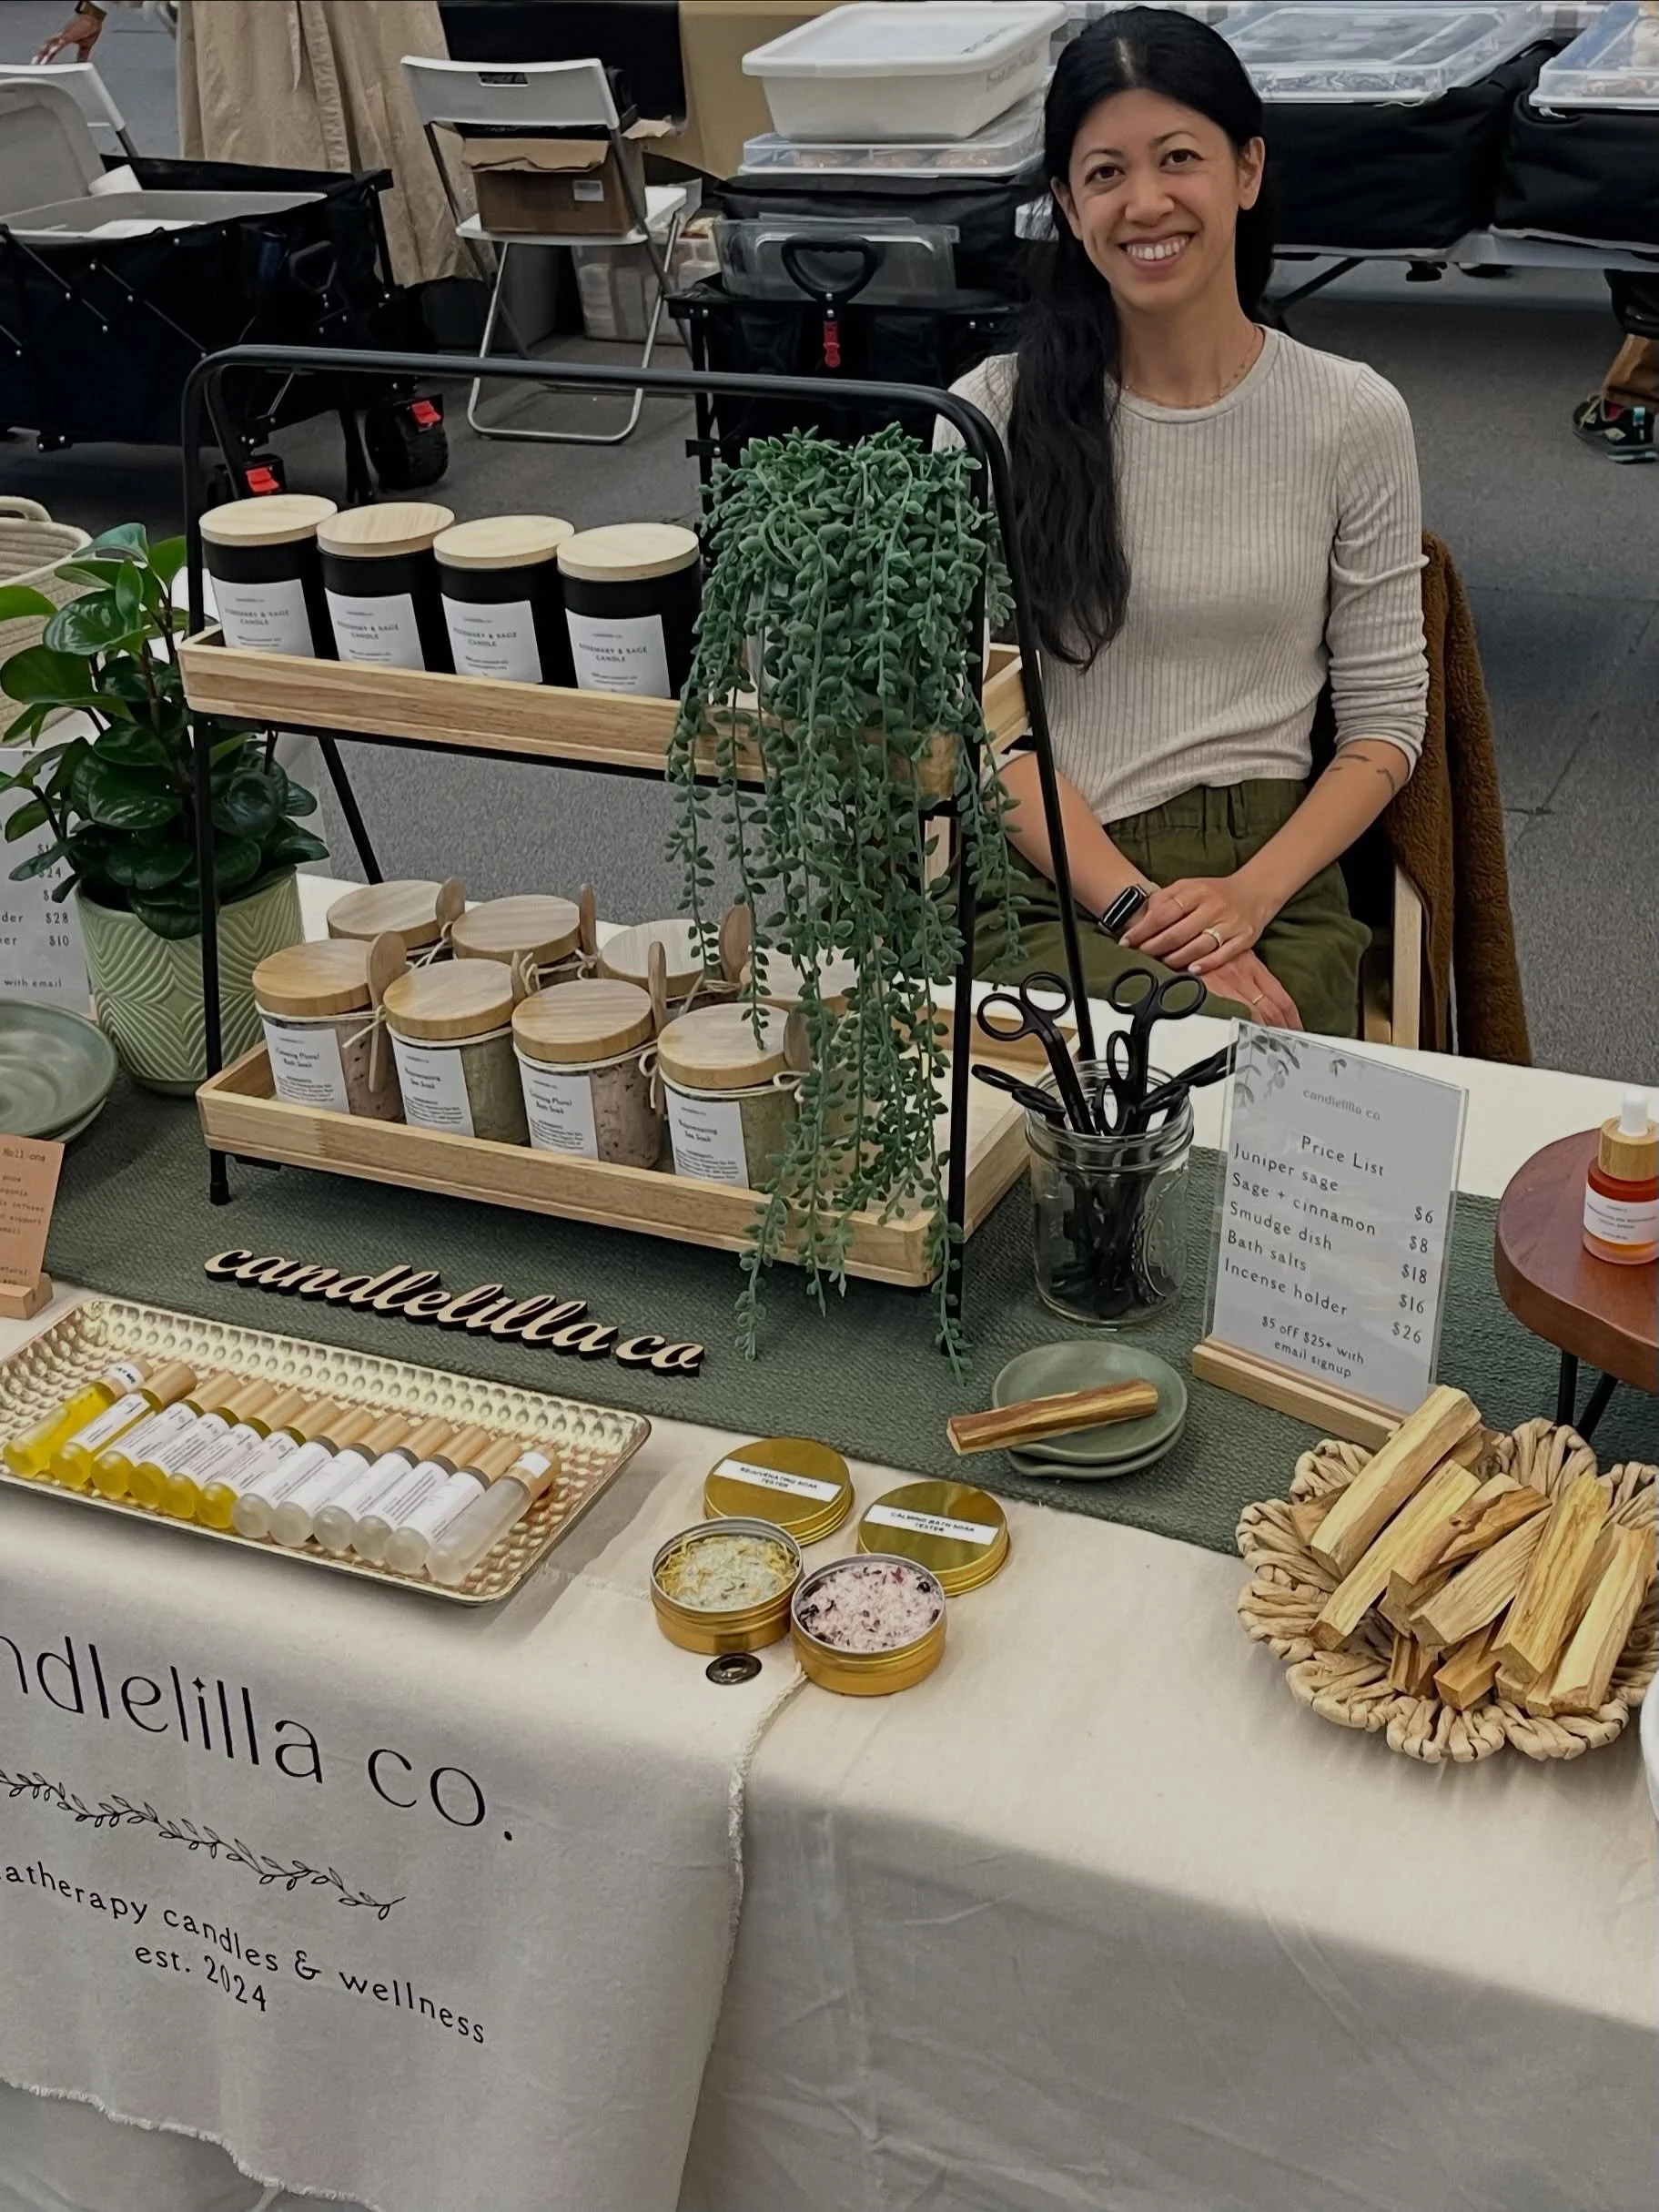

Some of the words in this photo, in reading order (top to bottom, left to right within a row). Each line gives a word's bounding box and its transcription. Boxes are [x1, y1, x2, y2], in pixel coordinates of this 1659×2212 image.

[46, 911, 69, 924] $28
[49, 935, 69, 947] $10
[32, 979, 62, 988] email
[1303, 1090, 1362, 1115] candlelilla
[1366, 1109, 1381, 1121] co
[1234, 1143, 1295, 1176] Juniper
[1301, 1170, 1339, 1192] sage
[1414, 1205, 1434, 1223] $6
[1301, 1135, 1345, 1162] Price
[1353, 1152, 1384, 1176] List
[1229, 1201, 1291, 1234] Smudge
[1299, 1227, 1332, 1251] dish
[1401, 1263, 1428, 1284] $18
[1232, 1172, 1270, 1197] Sage
[1278, 1191, 1286, 1200] +
[1293, 1198, 1376, 1235] cinnamon
[1409, 1235, 1428, 1253] $8
[1225, 1258, 1286, 1294] Incense
[1294, 1284, 1348, 1315] holder
[1391, 1322, 1421, 1344] $26
[1228, 1230, 1262, 1255] Bath
[1270, 1248, 1307, 1271] salts
[1399, 1294, 1424, 1314] $16
[204, 1248, 619, 1355] candlelilla
[615, 1334, 704, 1376] co
[1262, 1315, 1276, 1329] $5
[1280, 1324, 1300, 1339] off
[1303, 1331, 1332, 1349] $25+
[1336, 1346, 1364, 1365] with
[1274, 1341, 1307, 1361] email
[1311, 1354, 1352, 1378] signup
[890, 1511, 927, 1523] CALMING
[368, 1748, 513, 1842] co.
[0, 1861, 147, 1923] atherapy
[164, 1907, 279, 1972] candles
[294, 1949, 322, 1981] &
[339, 1972, 485, 2045] wellness
[135, 1944, 190, 1974] est.
[205, 1954, 267, 2013] 2024
